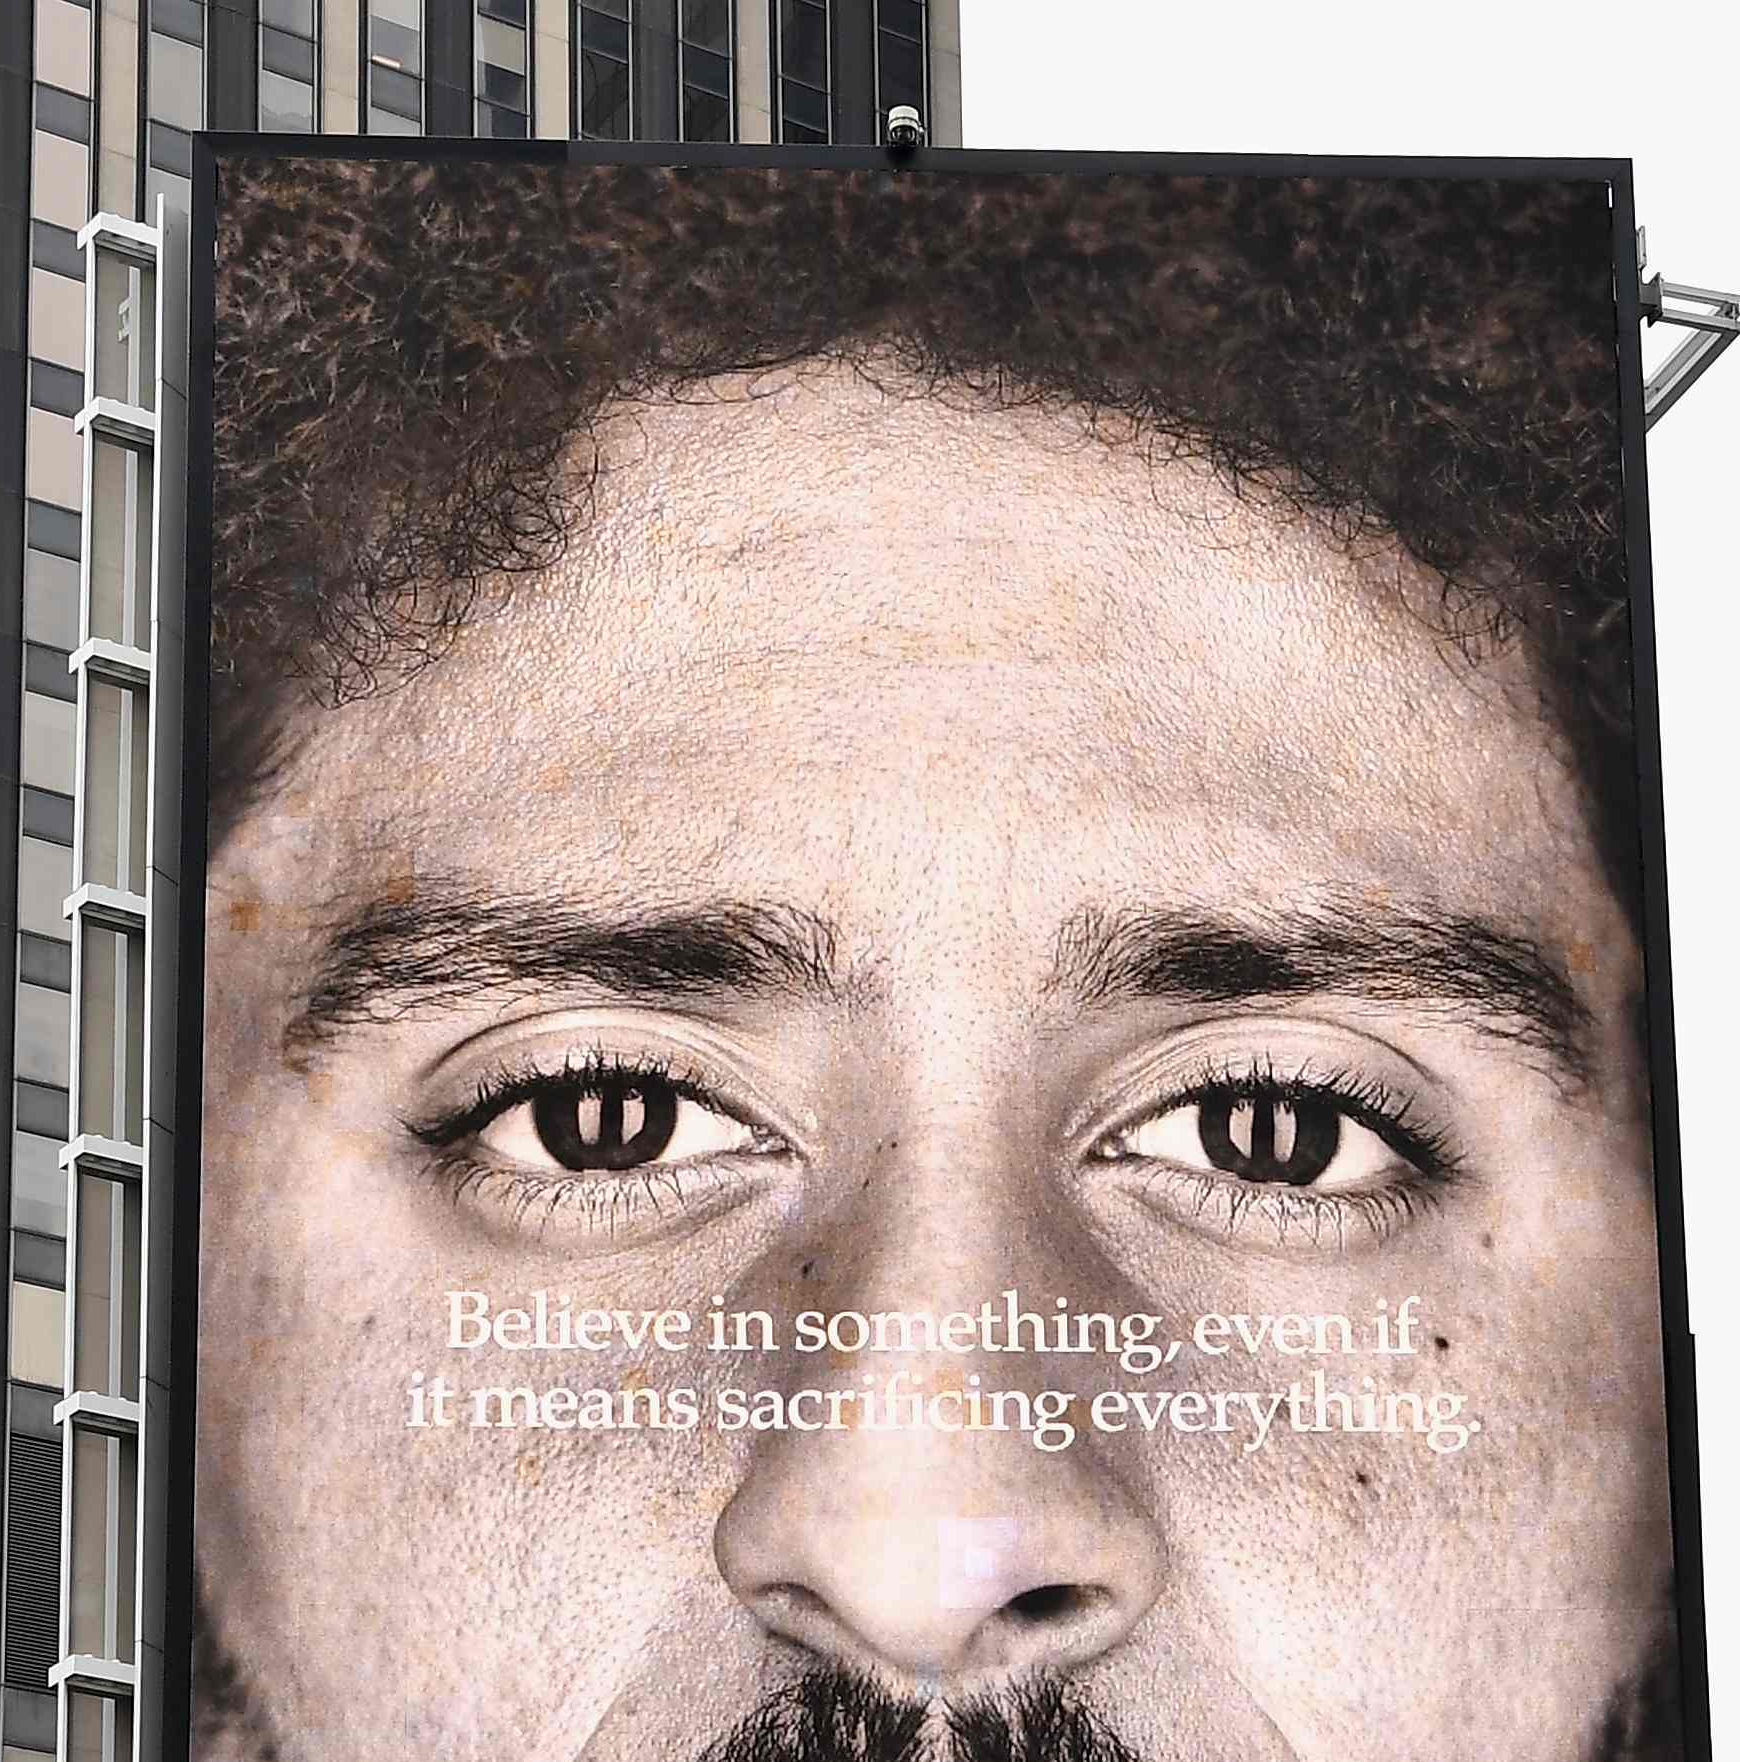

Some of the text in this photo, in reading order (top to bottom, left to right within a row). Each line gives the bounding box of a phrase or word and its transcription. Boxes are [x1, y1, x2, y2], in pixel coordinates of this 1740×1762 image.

[444, 1289, 1421, 1375] Believe in something, even if
[405, 1369, 1481, 1454] it means sacrificing everything.
